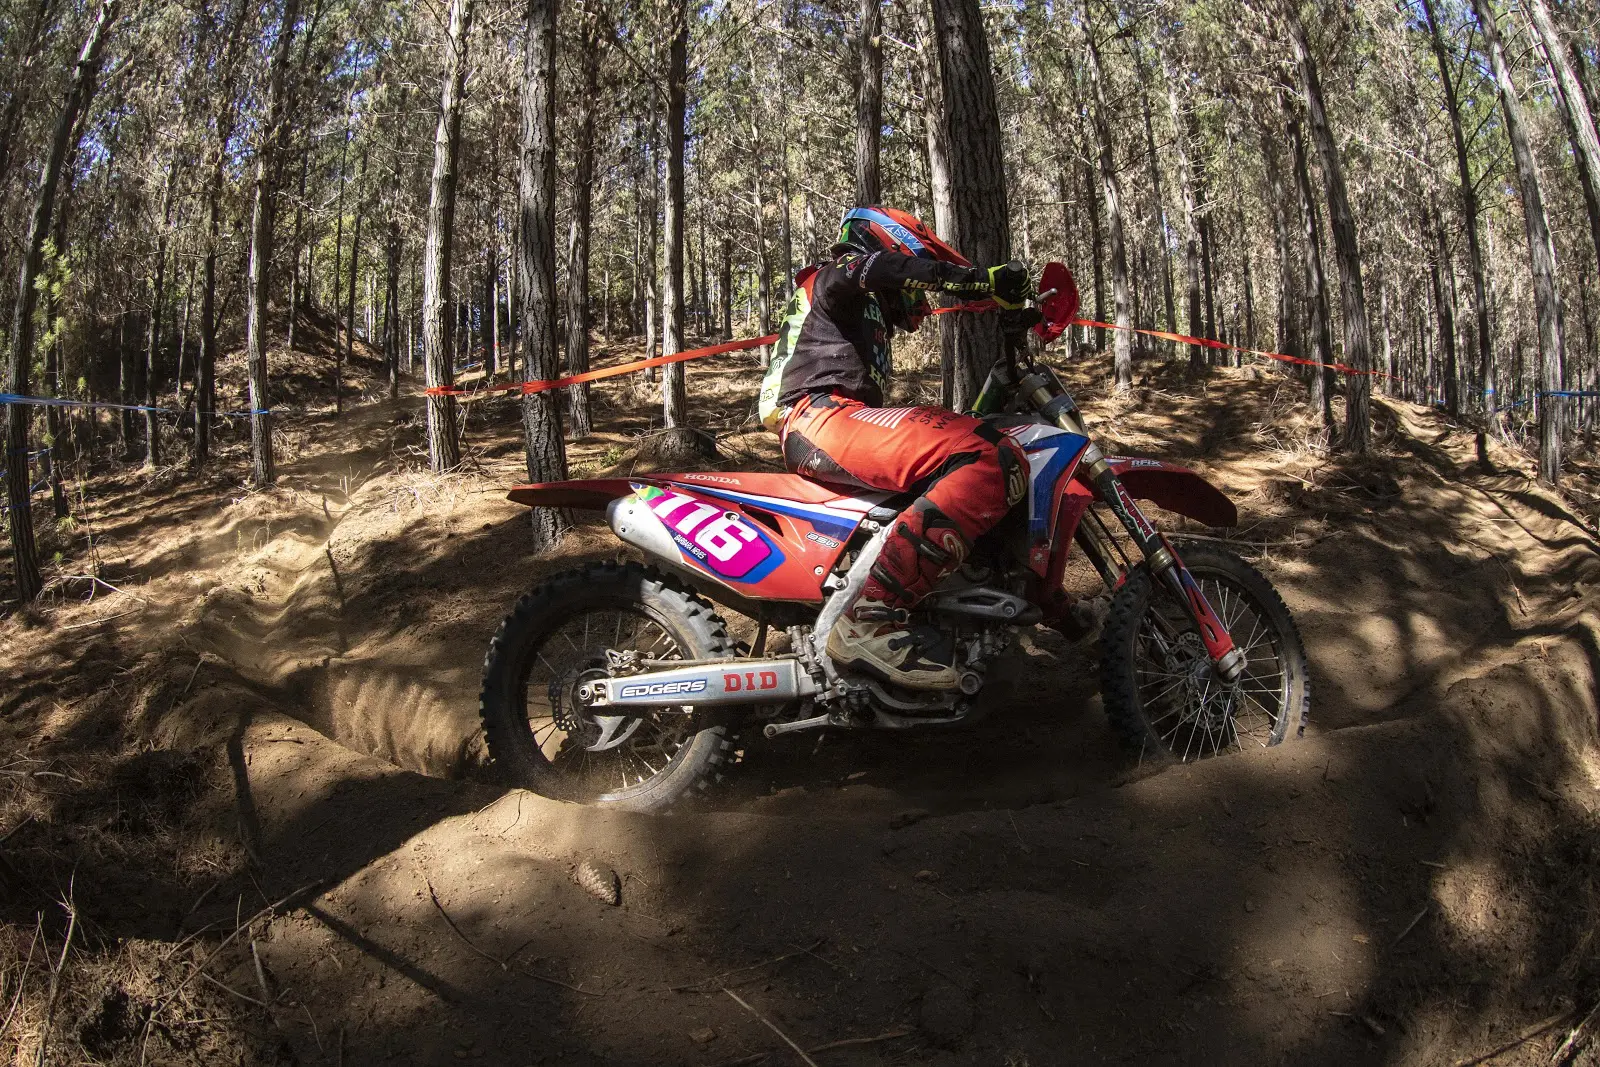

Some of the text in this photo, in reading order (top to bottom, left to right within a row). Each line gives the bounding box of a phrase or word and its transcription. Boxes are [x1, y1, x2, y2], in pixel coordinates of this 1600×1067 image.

[942, 280, 990, 293] Racing
[683, 473, 741, 486] HONDA
[652, 491, 759, 562] 116
[620, 680, 707, 697] EDGERS
